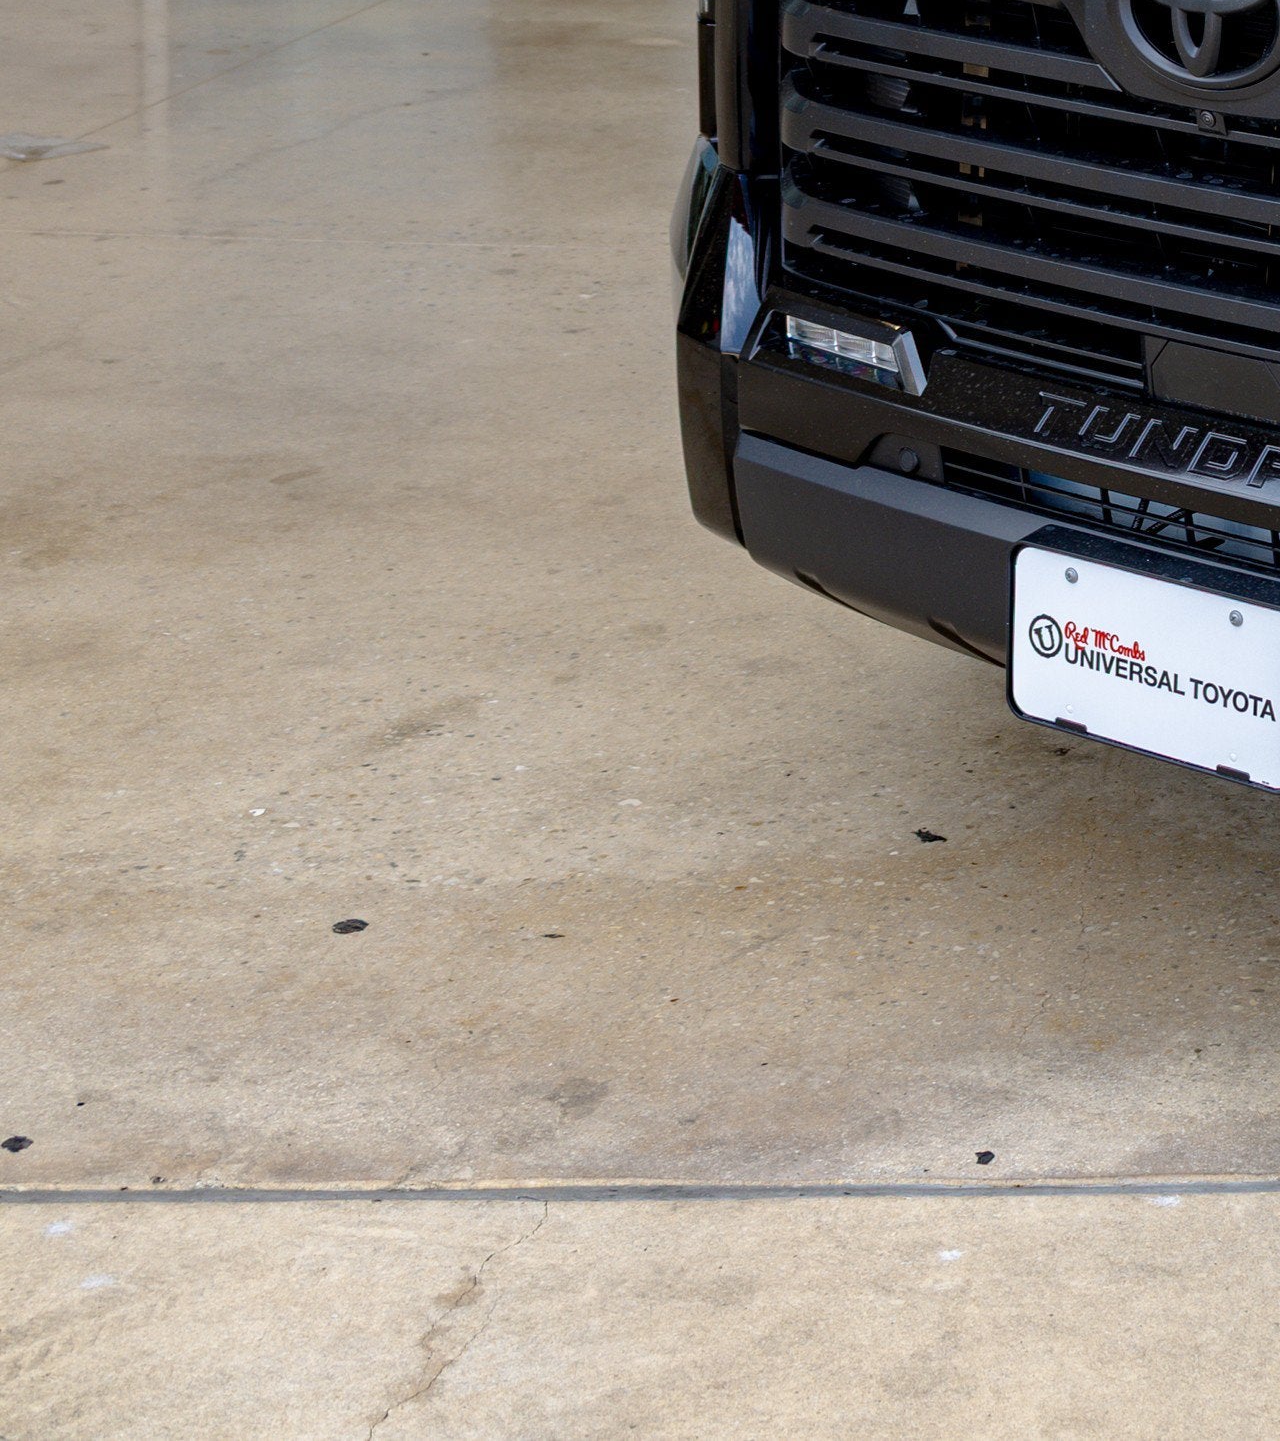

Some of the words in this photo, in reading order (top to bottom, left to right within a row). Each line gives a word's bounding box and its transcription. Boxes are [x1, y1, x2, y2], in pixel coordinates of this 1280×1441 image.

[1064, 621, 1090, 647] Red
[1091, 628, 1146, 661] McCombs
[1065, 643, 1186, 696] UNIVERSAL
[1190, 678, 1276, 722] TOYOTA
